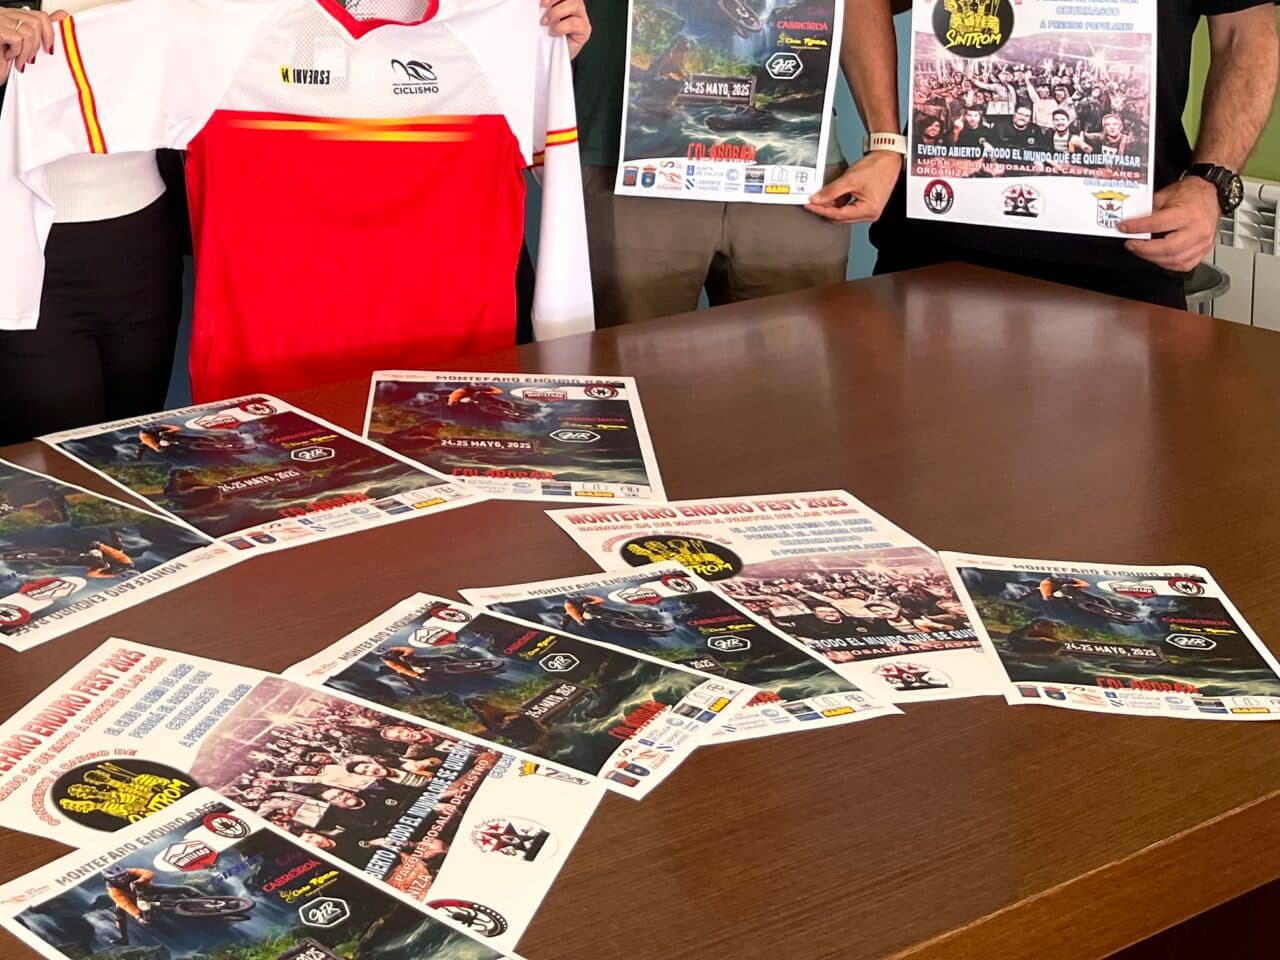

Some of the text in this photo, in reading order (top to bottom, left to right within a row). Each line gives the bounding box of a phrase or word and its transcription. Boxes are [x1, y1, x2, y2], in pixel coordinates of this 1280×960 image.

[393, 86, 439, 95] CICLISMO
[684, 81, 705, 94] 24-25
[732, 83, 751, 95] 2025
[917, 144, 947, 157] EVENTO
[948, 146, 980, 158] ABIERTO
[991, 147, 1011, 159] TODO
[1012, 149, 1022, 160] EL
[1023, 150, 1051, 162] MUNDO
[1053, 152, 1070, 164] QUE
[1071, 153, 1081, 164] SE
[1115, 154, 1141, 168] PASAR
[1113, 170, 1140, 178] ARES
[569, 506, 678, 526] MONTEFARO
[680, 500, 754, 519] ENDURO
[757, 497, 800, 514] FEST
[805, 494, 849, 511] 2025
[690, 562, 733, 580] TROM
[850, 635, 865, 646] EL
[933, 629, 952, 641] SE
[25, 691, 92, 738] ENDURO
[71, 661, 123, 696] FEST
[109, 647, 147, 673] 2025
[462, 759, 489, 797] CASTRO
[55, 842, 137, 887] MONTEFARO
[136, 815, 186, 846] ENDURO
[363, 845, 393, 881] BIERTO
